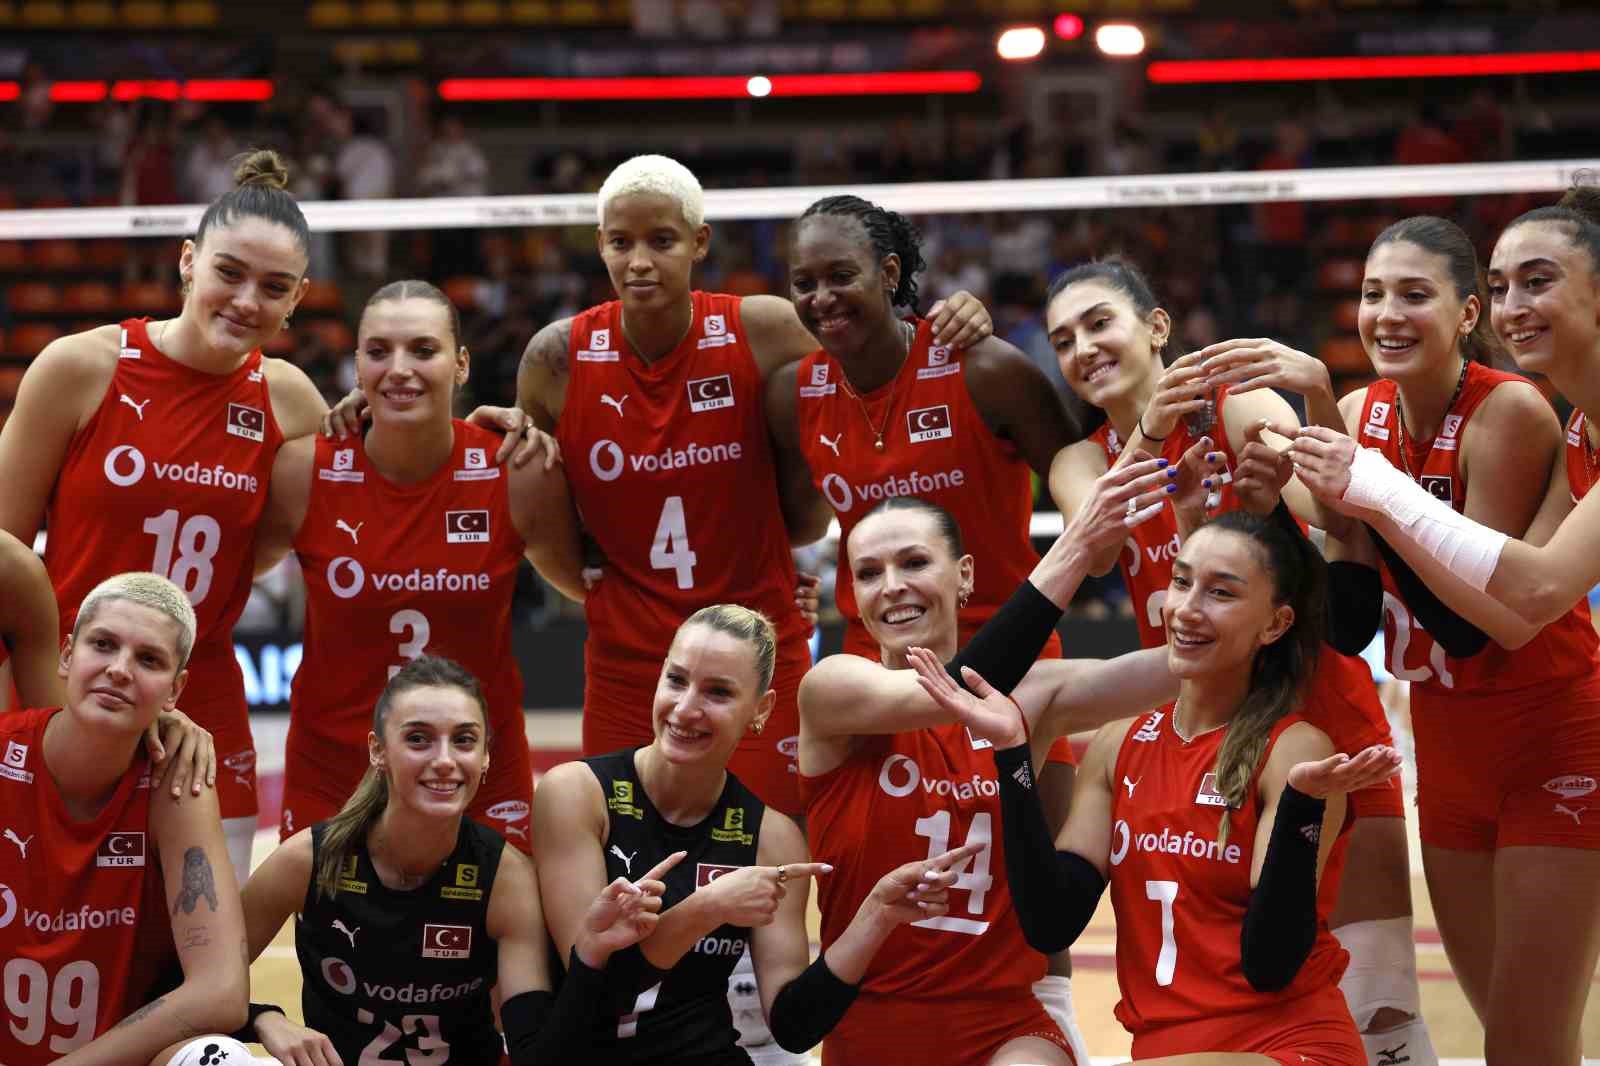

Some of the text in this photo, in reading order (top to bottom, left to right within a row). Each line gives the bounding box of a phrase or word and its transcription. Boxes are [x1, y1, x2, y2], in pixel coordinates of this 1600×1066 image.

[595, 333, 607, 346] S
[701, 399, 725, 409] TUR
[1372, 406, 1384, 420] S
[235, 426, 257, 439] TUR
[919, 430, 942, 440] TUR
[469, 451, 481, 465] S
[630, 440, 742, 473] vodafone
[153, 460, 257, 494] vodafone
[855, 467, 965, 502] vodafone
[457, 533, 480, 542] TUR
[650, 496, 697, 590] 4
[143, 508, 222, 608] 18
[372, 568, 490, 592] vodafone
[9, 748, 24, 763] S
[615, 784, 629, 798] S
[730, 811, 743, 826] S
[1135, 827, 1241, 864] vodafone
[107, 857, 135, 865] TUR
[460, 867, 475, 882] S
[23, 904, 136, 932] vodafone
[1145, 879, 1179, 987] 7
[433, 949, 460, 959] TUR
[362, 977, 483, 1004] vodafone
[3, 957, 101, 1055] 99
